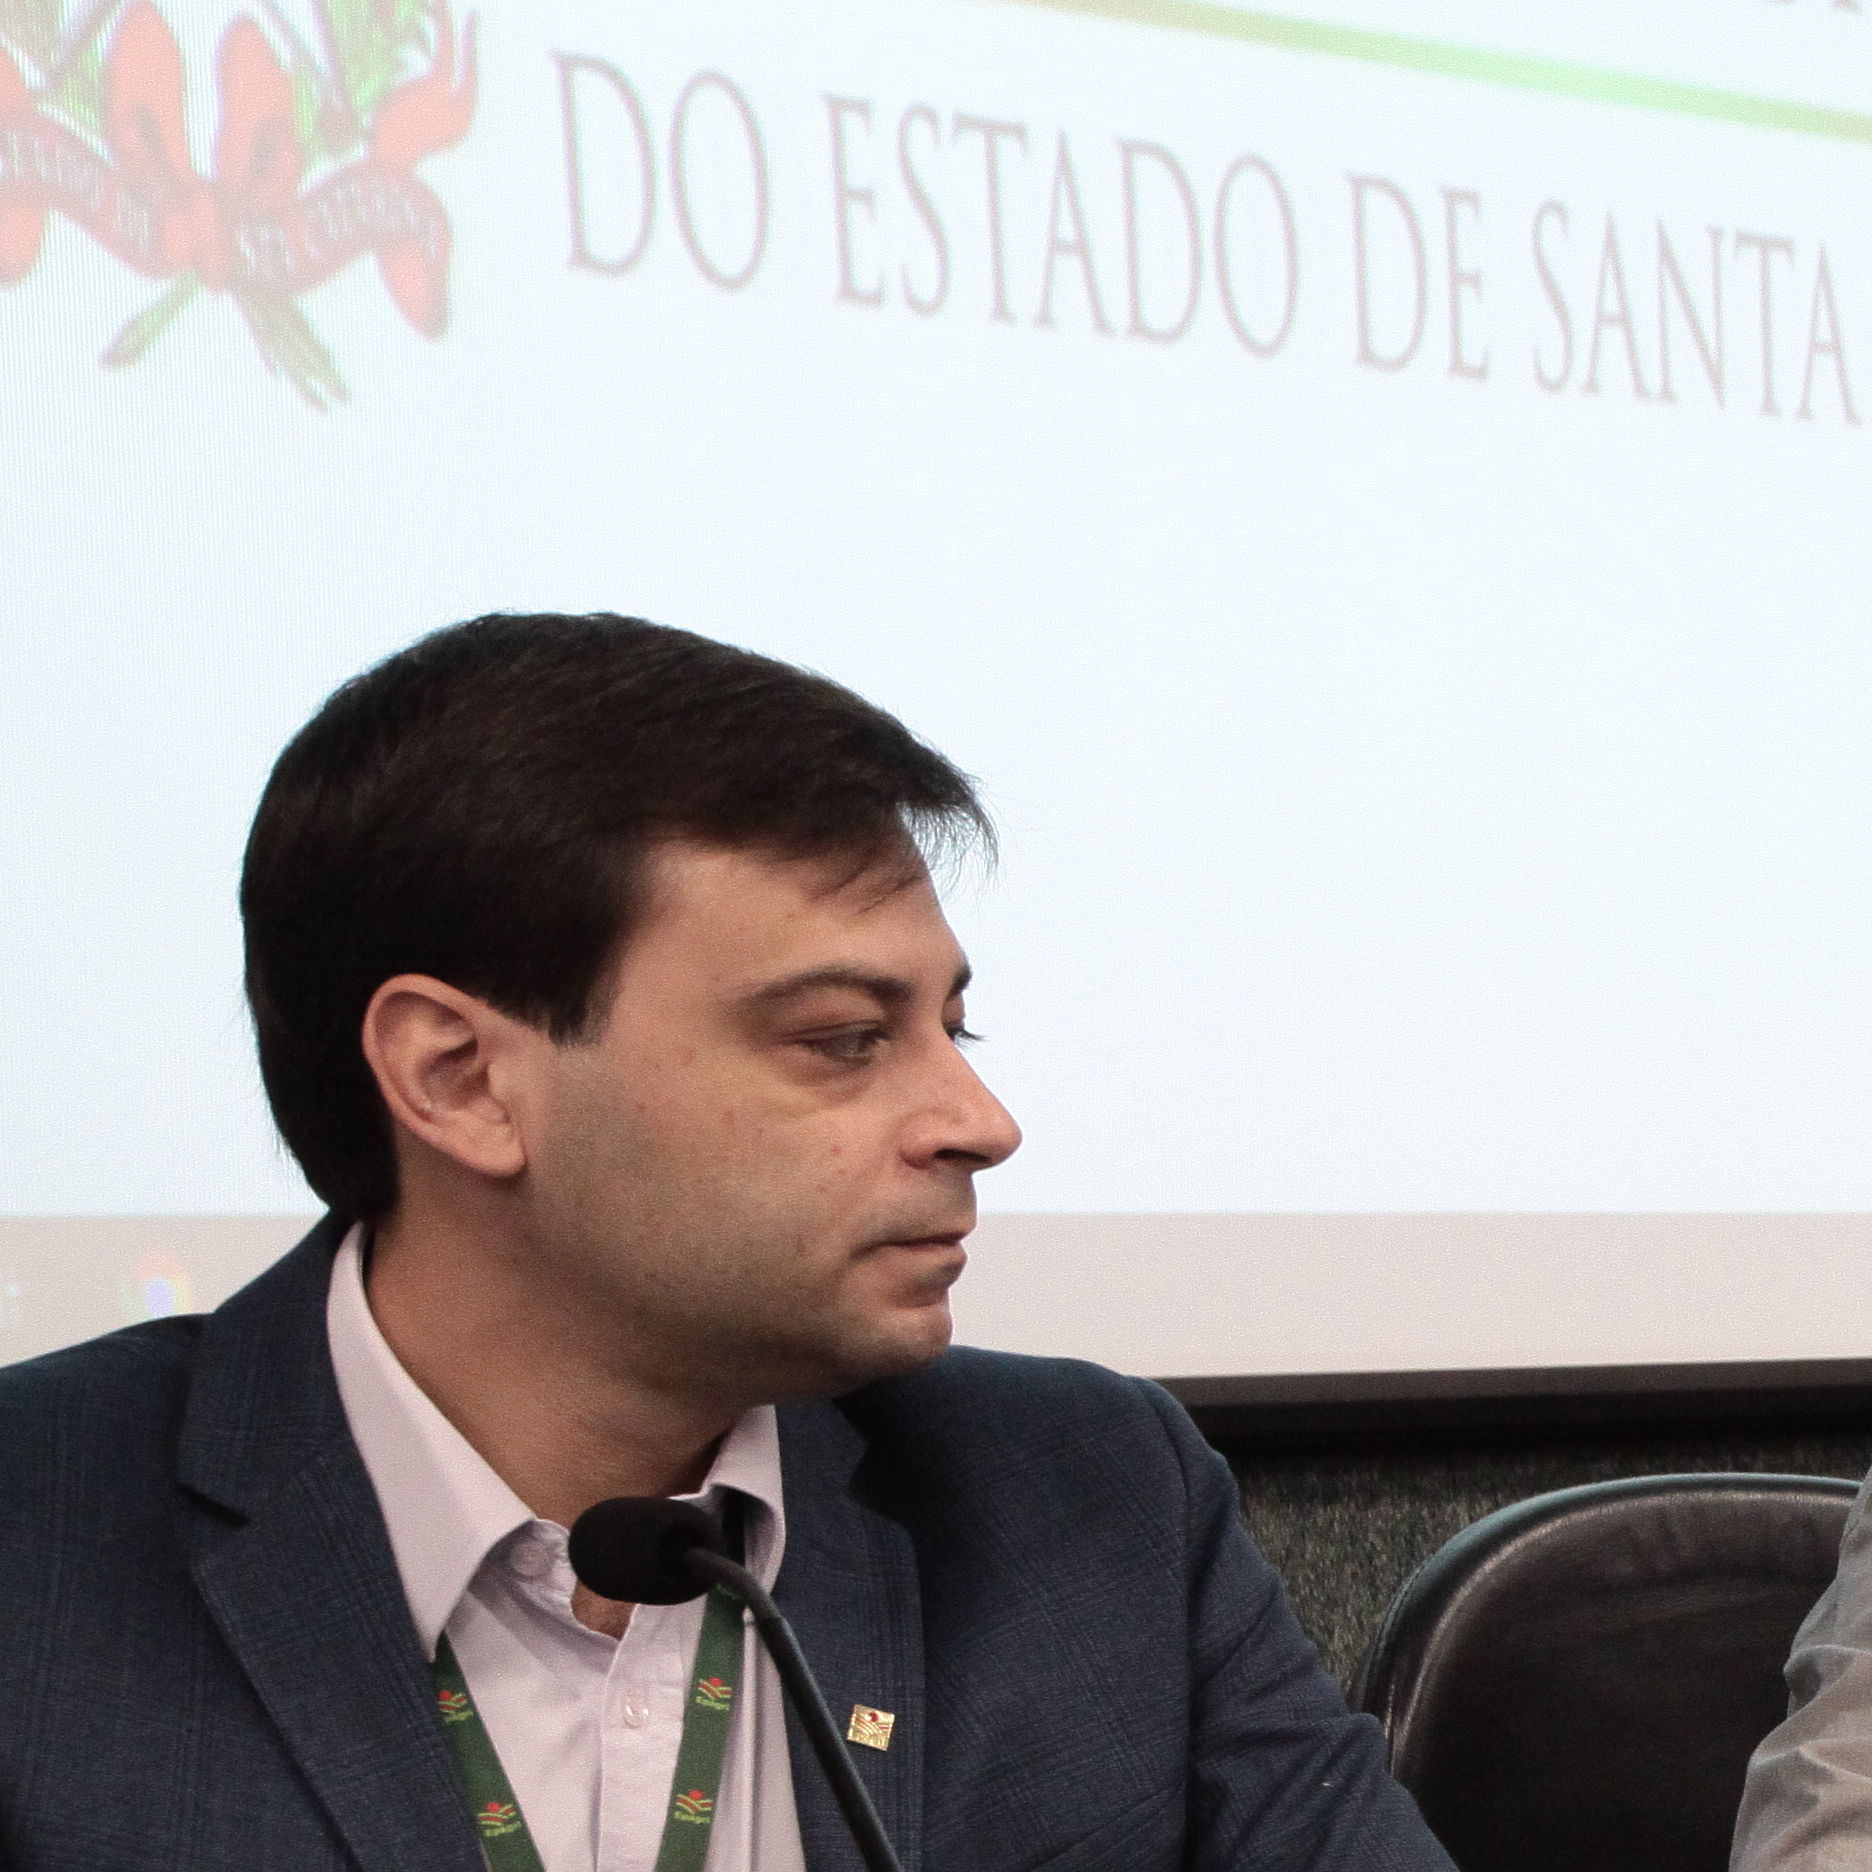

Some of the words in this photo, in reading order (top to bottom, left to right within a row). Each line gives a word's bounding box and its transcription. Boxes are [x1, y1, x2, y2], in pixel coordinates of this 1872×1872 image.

[549, 50, 771, 293] DO
[822, 92, 1300, 359] ESTADO
[1346, 172, 1490, 382] DE
[1531, 199, 1861, 426] SANTA
